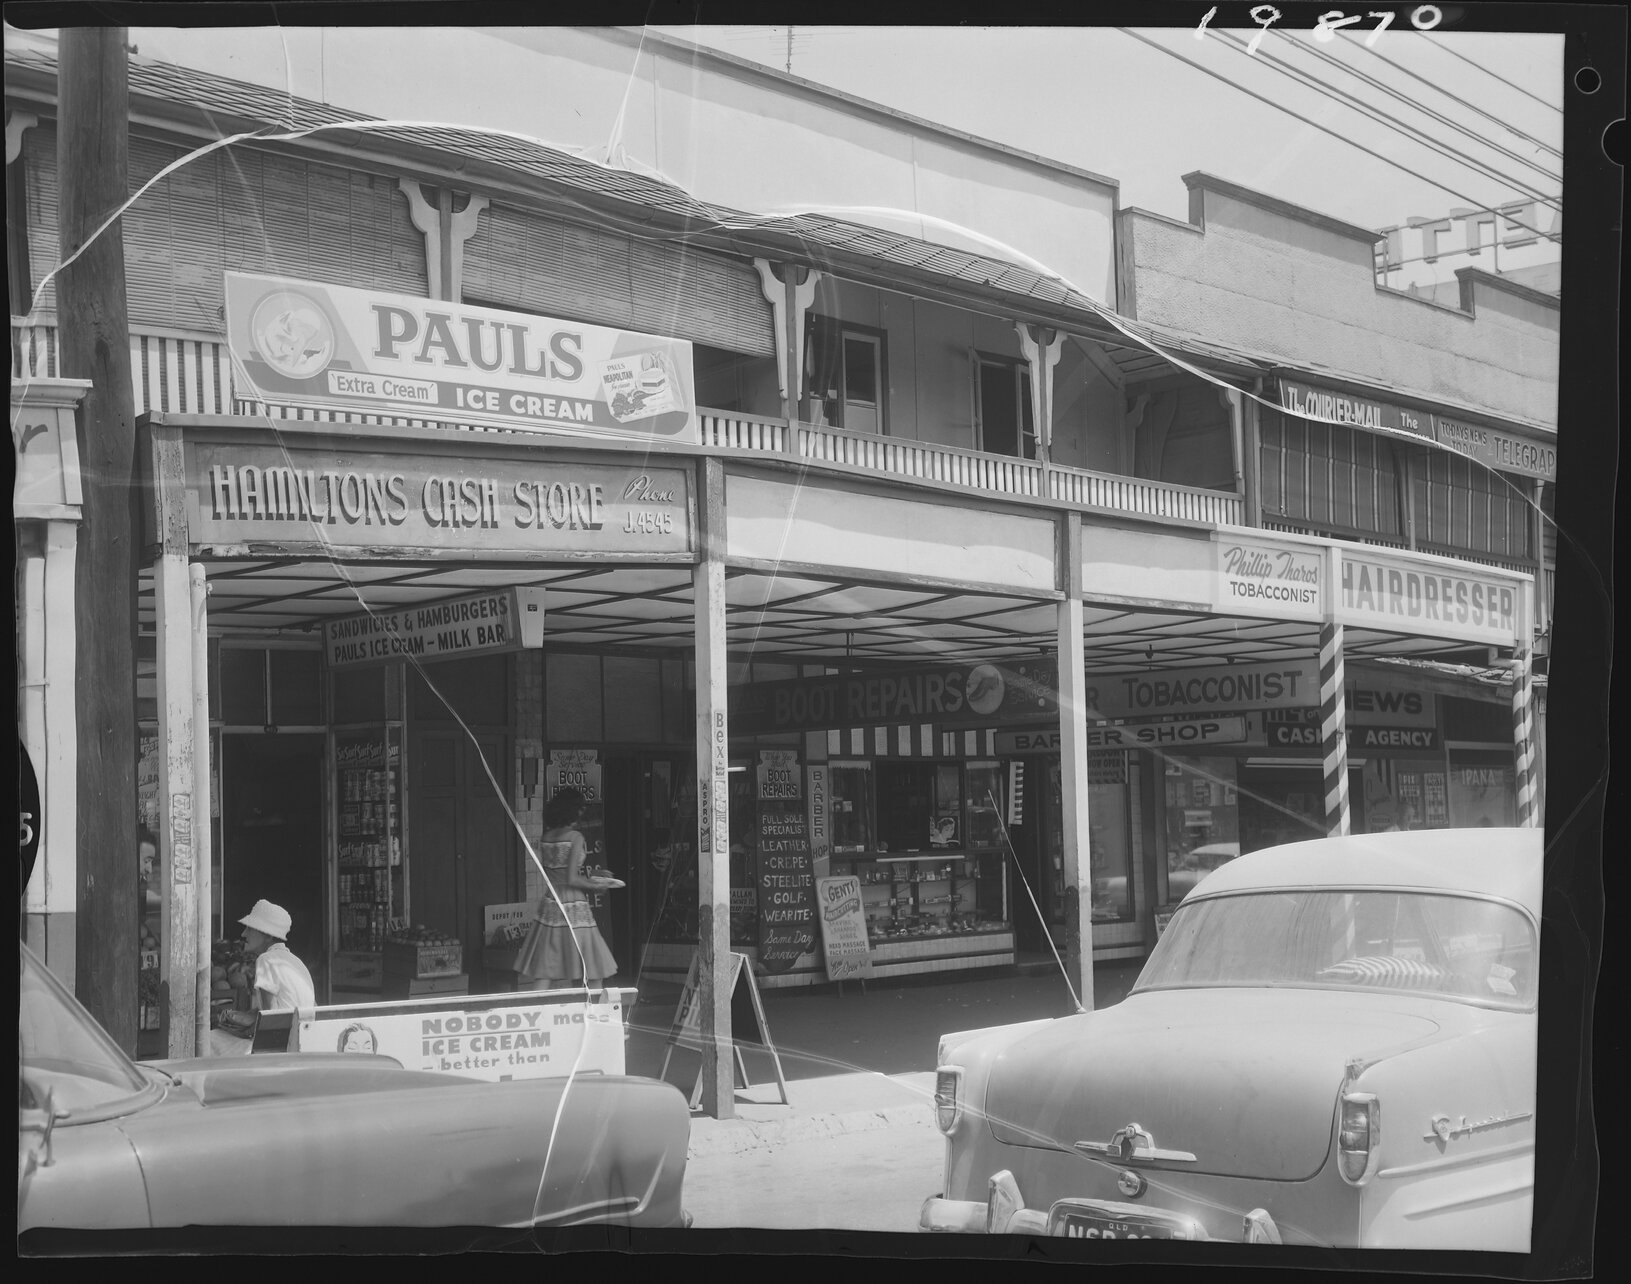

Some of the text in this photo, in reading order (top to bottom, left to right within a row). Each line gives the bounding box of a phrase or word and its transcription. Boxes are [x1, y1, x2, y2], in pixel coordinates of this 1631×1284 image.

[371, 304, 584, 381] PAULS
[456, 388, 594, 422] ICE CREAM
[1306, 392, 1380, 427] COURIER-MAIL
[1401, 412, 1418, 429] The
[1494, 436, 1556, 474] TELEGRAP
[209, 465, 604, 532] HAMILTONS CASH STORE
[623, 475, 677, 503] Phone
[1223, 547, 1318, 584] Phillip Tharos
[1230, 581, 1317, 604] TOBACCONIST
[1341, 561, 1513, 631] HAIRDRESSER
[404, 613, 414, 632] &
[417, 596, 508, 629] HAMBURGERS
[334, 643, 367, 663] PAULS
[369, 639, 389, 658] ICE
[437, 628, 472, 651] MILK
[477, 624, 507, 645] BAR
[775, 671, 964, 725] BOOT REPAIRS
[1122, 671, 1303, 709] TOBACCONIST
[1345, 689, 1424, 715] EWS
[1014, 723, 1220, 750] BARER SHOP
[1365, 730, 1432, 746] AGENCY
[559, 770, 588, 786] BOOT
[768, 769, 791, 782] BOOT
[1461, 769, 1496, 786] IPANA
[762, 783, 798, 797] REPAIRS
[813, 770, 824, 837] BARBER
[762, 814, 782, 824] FULL
[762, 839, 808, 852] LEATHER
[769, 856, 804, 869] CREPE
[763, 874, 812, 888] STEELITE
[773, 892, 803, 905] GOLF
[764, 909, 810, 922] WEARITE
[764, 929, 814, 949] Same Day
[422, 1012, 541, 1035] NOBODY
[422, 1033, 551, 1056] ICE CREAM
[440, 1053, 550, 1072] better than
[1108, 1222, 1129, 1231] QLD
